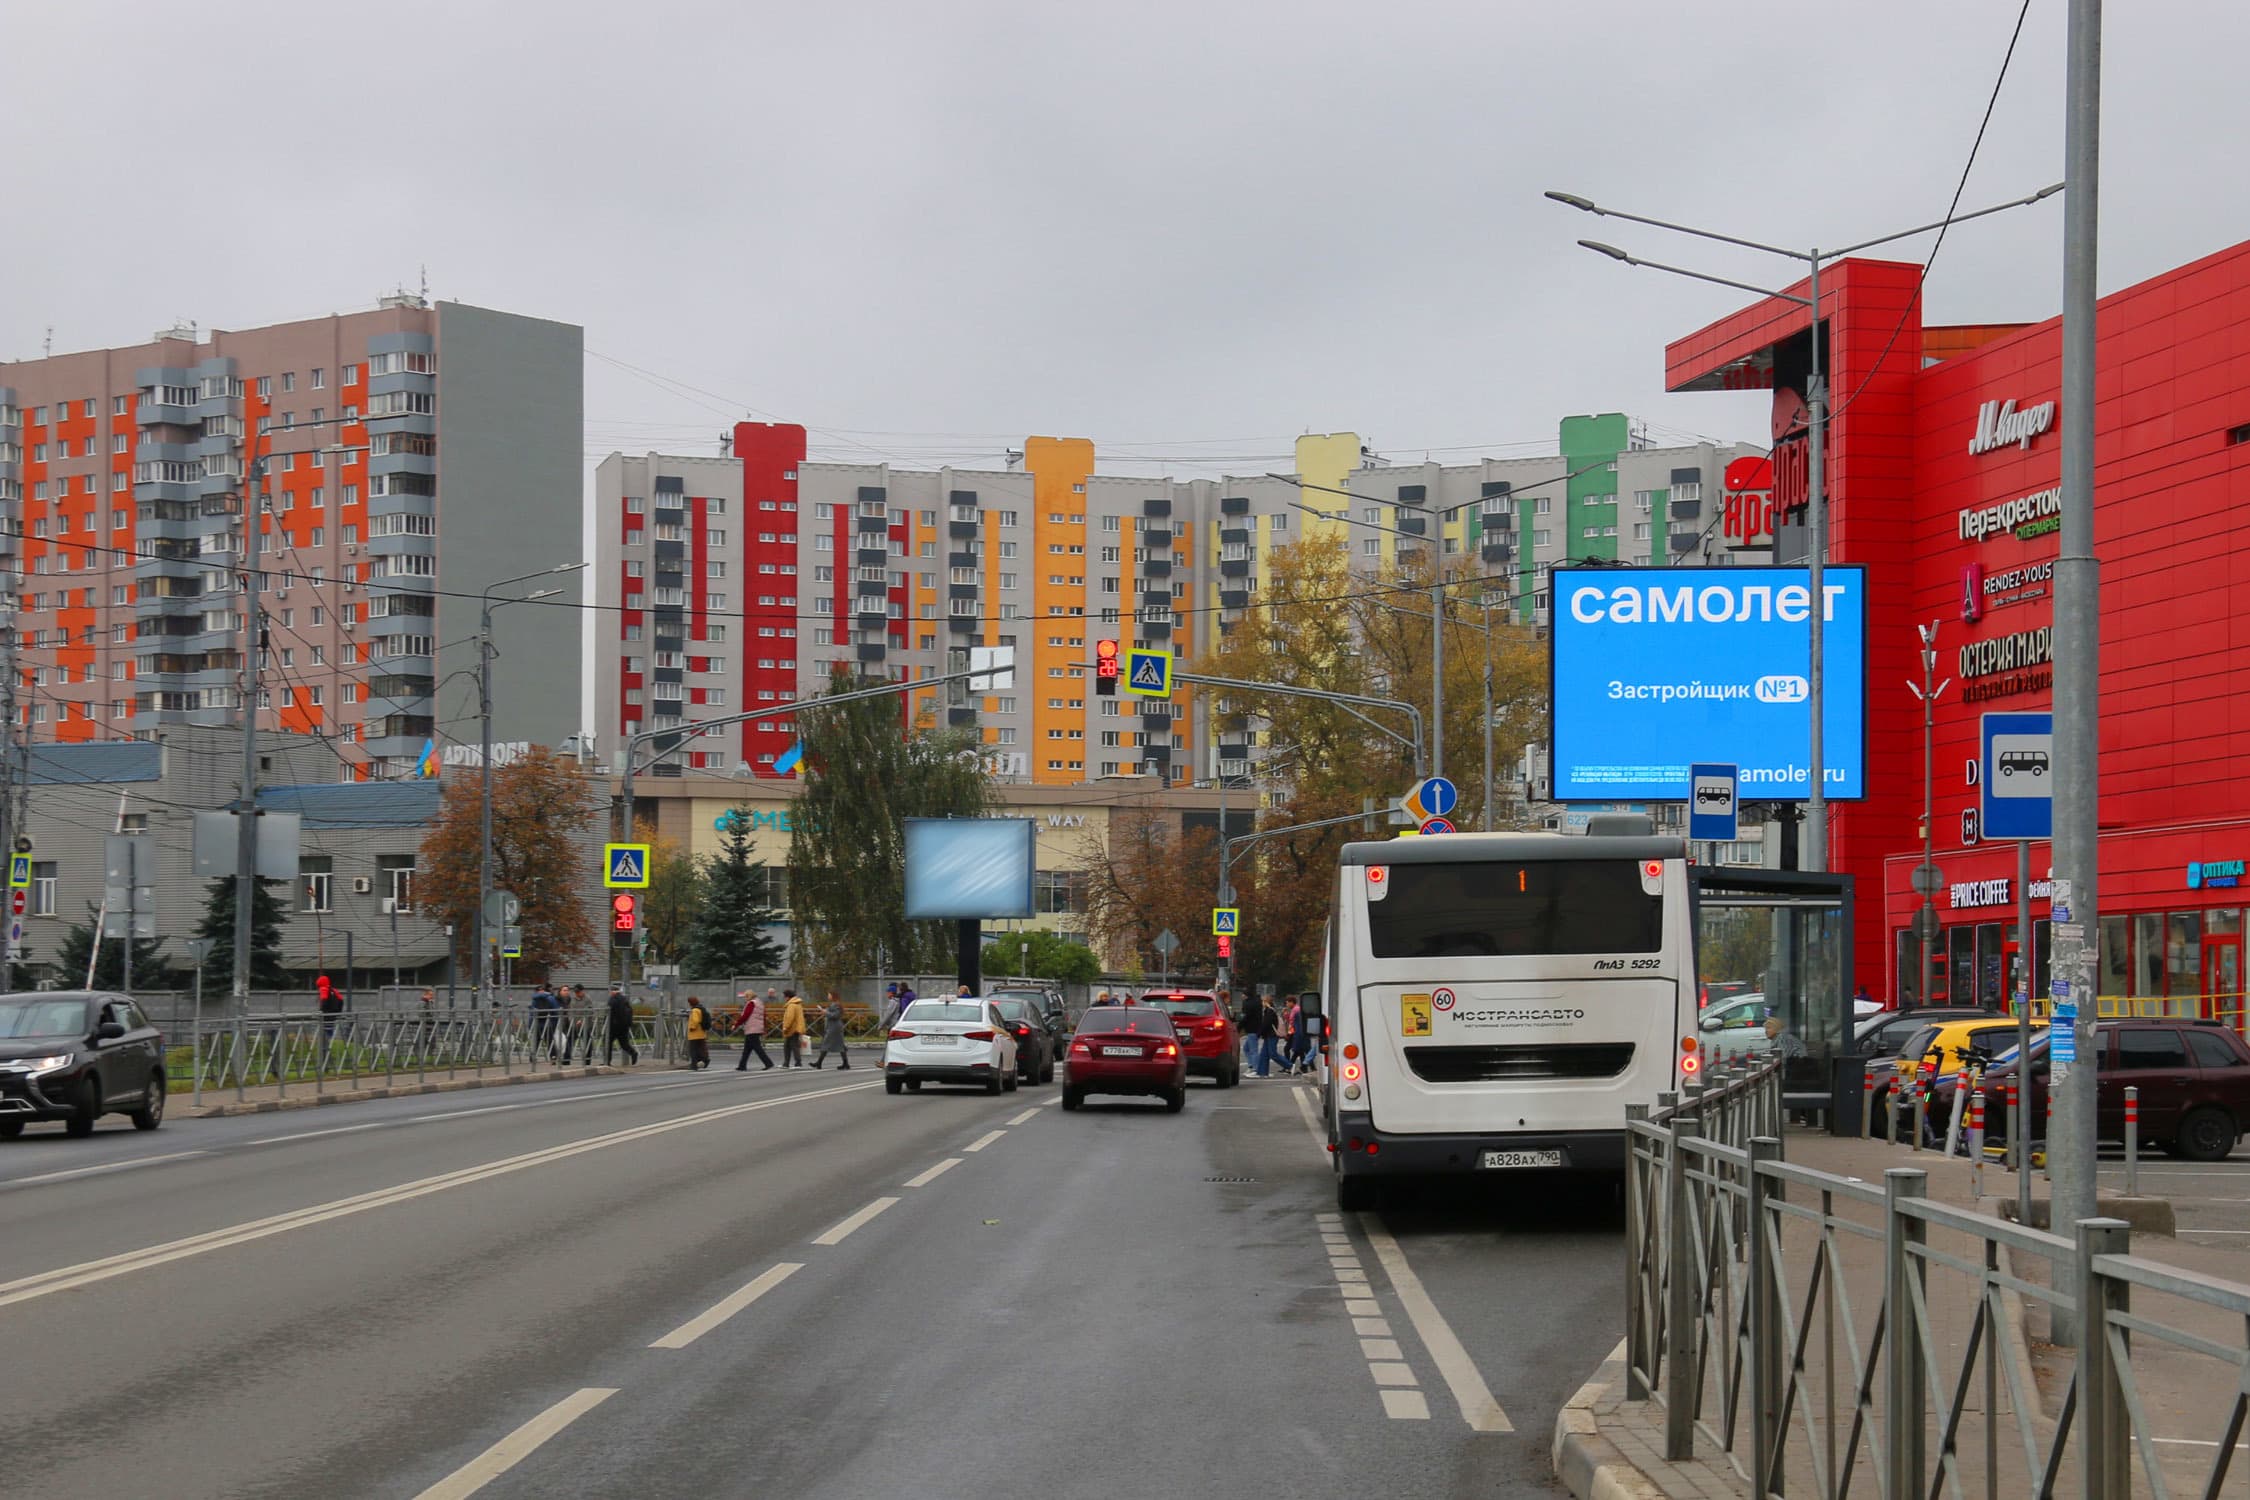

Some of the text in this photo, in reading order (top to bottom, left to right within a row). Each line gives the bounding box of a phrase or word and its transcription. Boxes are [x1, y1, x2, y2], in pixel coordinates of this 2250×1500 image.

[1983, 562, 2052, 595] RENDEZ-VOUS
[1570, 585, 1845, 623] самолет
[1959, 635, 2014, 679] ОСТЕРИЯ
[1099, 659, 1116, 676] 28
[1607, 679, 1802, 702] Застройщик №1
[1048, 814, 1086, 827] WAY
[2203, 860, 2246, 878] ОПТИКА
[1518, 869, 1527, 892] 1
[1956, 881, 1979, 907] PRICE
[1980, 879, 2009, 905] COFFEE
[616, 913, 633, 929] 28
[1630, 959, 1661, 969] 5292
[1436, 993, 1451, 1005] 60
[1453, 1009, 1585, 1021] МОСТРАНСАВТО
